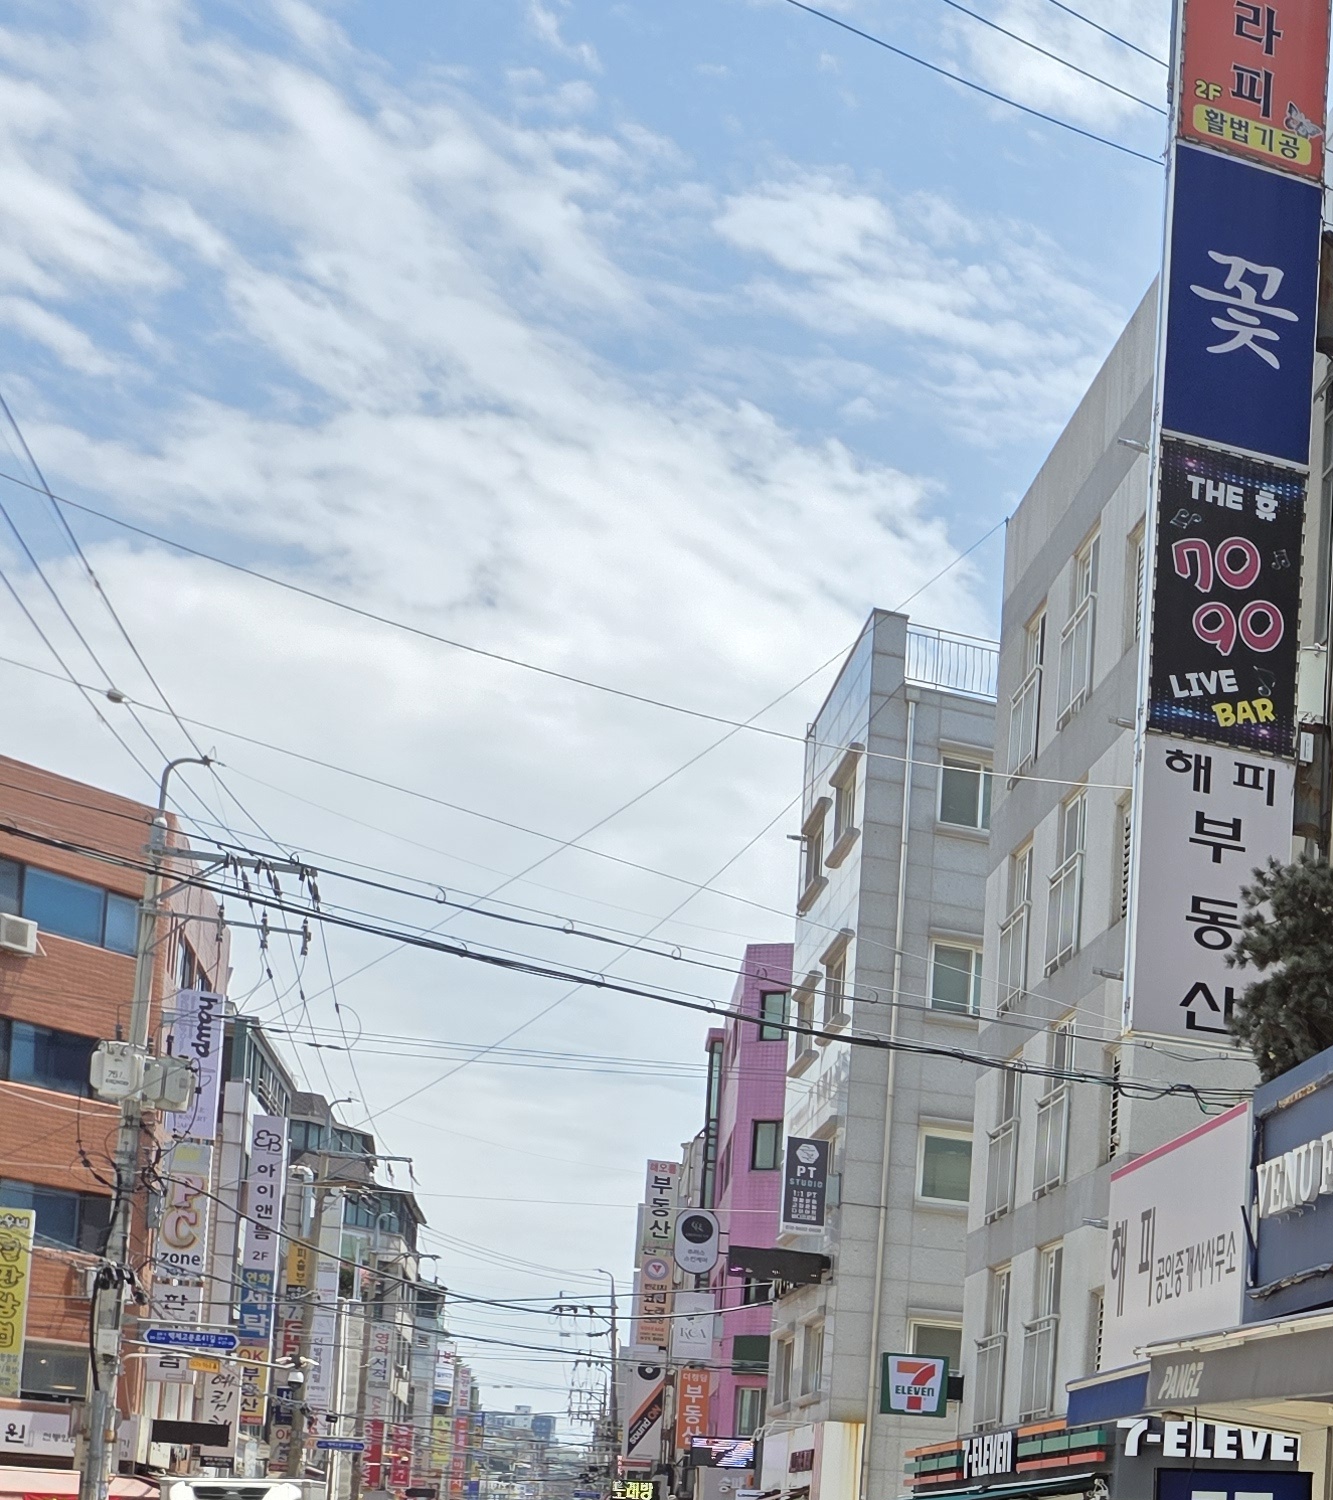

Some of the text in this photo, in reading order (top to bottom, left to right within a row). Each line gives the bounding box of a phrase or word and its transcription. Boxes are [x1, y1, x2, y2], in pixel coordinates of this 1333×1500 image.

[1195, 79, 1222, 101] 2F
[1204, 108, 1300, 160] 활법기공
[1190, 250, 1299, 370] 꽃
[1187, 474, 1244, 511] THE
[1192, 600, 1285, 657] 90
[1169, 669, 1239, 698] LIVE
[1211, 698, 1276, 728] BAR
[1165, 748, 1276, 807] 해피
[789, 1177, 823, 1189] STUDIO
[796, 1165, 818, 1179] PT
[1256, 1139, 1323, 1219] VENU
[650, 1176, 672, 1239] 부동산
[160, 1251, 201, 1266] zone
[252, 1251, 269, 1261] 2F
[1156, 1231, 1236, 1304] 공인중개사사무소
[680, 1328, 707, 1340] KCA
[239, 1349, 264, 1361] OK
[895, 1384, 935, 1397] ELEVEN
[1158, 1361, 1204, 1399] PANGZ
[628, 1418, 652, 1445] sound
[962, 1431, 1012, 1479] 7-ELEVEN
